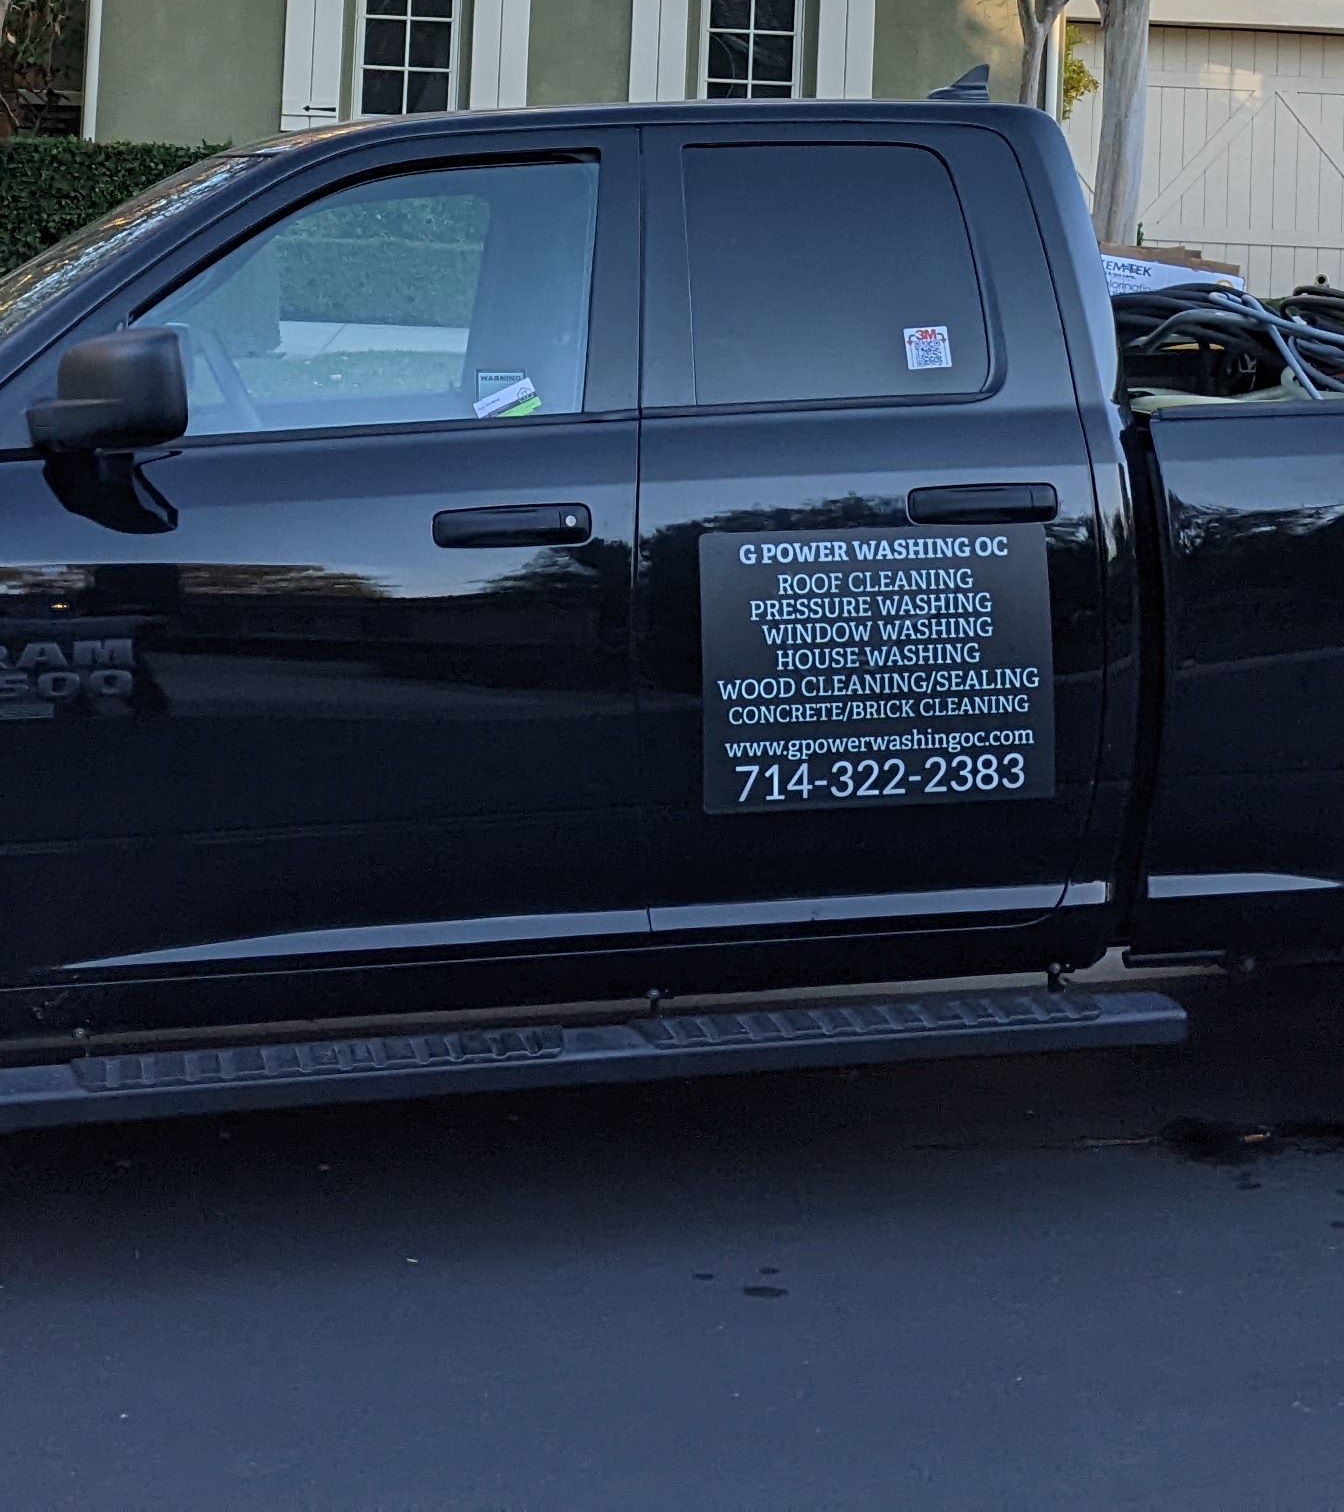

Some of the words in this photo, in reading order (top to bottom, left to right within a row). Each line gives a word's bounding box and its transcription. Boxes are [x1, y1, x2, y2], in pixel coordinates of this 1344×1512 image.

[916, 328, 937, 340] 3M
[739, 544, 757, 565] G
[761, 541, 849, 564] POWER
[852, 538, 971, 561] WASHING
[974, 536, 1008, 558] OC
[778, 572, 842, 594] ROOF
[848, 568, 974, 592] CLEANING
[750, 596, 872, 620] PRESSURE
[876, 592, 992, 616] WASHING
[762, 622, 872, 645] WINDOW
[877, 616, 994, 640] WASHING
[776, 648, 860, 670] HOUSE
[864, 643, 980, 666] WASHING
[718, 678, 796, 700] WOOD
[801, 668, 1040, 697] CLEANING/SEALING
[728, 699, 915, 725] CONCRETE/BRICK
[920, 695, 1030, 716] CLEANING
[725, 728, 1034, 760] www.gpowerwashingoc.com
[735, 752, 1026, 802] 714-322-2383
